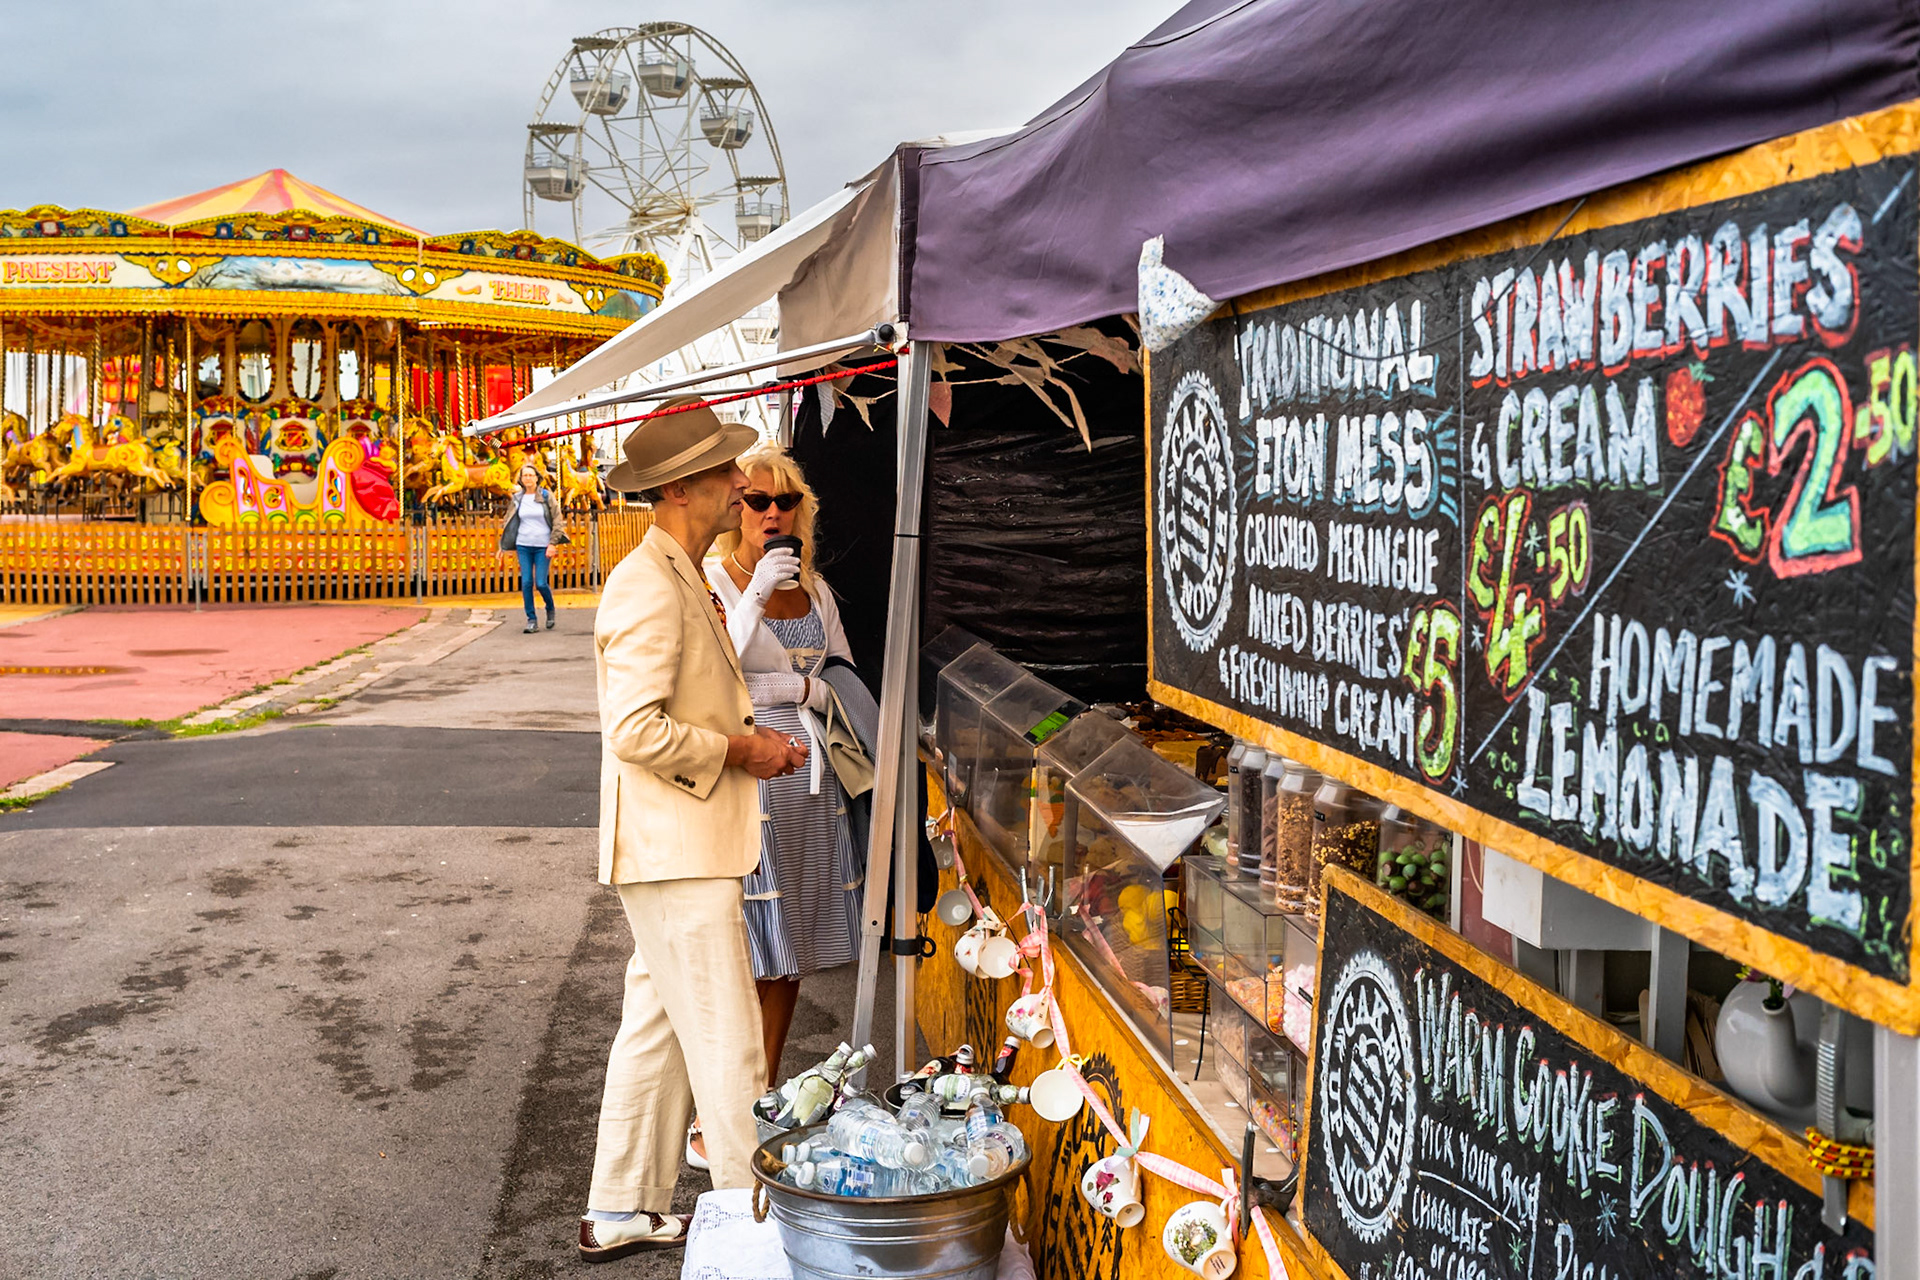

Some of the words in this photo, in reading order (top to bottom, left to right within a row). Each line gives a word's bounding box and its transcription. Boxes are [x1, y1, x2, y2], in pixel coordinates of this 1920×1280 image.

[3, 261, 116, 283] PRESENT
[489, 280, 550, 304] THEIR
[1470, 203, 1863, 381] STRAWBERRIES
[1234, 299, 1435, 420] TRADITIONAL
[1171, 398, 1221, 474] CAKE
[1255, 412, 1326, 498] ETON
[1334, 409, 1434, 512] MESS
[1497, 376, 1661, 489] CREAM
[1166, 504, 1182, 572] UP
[1180, 504, 1229, 621] NORTH
[1244, 513, 1319, 572] CRUSHED
[1327, 519, 1440, 595] MERINGUE
[1248, 583, 1308, 654] MIXED
[1334, 679, 1415, 769] CREAM
[1590, 612, 1898, 776] HOMEMADE
[1517, 686, 1863, 930] LEMONADE
[1342, 985, 1402, 1077] CAKE
[1328, 1068, 1344, 1138] UP
[1414, 970, 1508, 1141] WARM
[1513, 1027, 1621, 1193] COOKIE
[1629, 1096, 1792, 1280] DOUGH
[1339, 1109, 1404, 1209] NORTH
[1421, 1114, 1455, 1169] PICK
[1459, 1131, 1499, 1200] YOUR
[1412, 1184, 1493, 1255] CHOCOLATE
[1430, 1243, 1446, 1271] or
